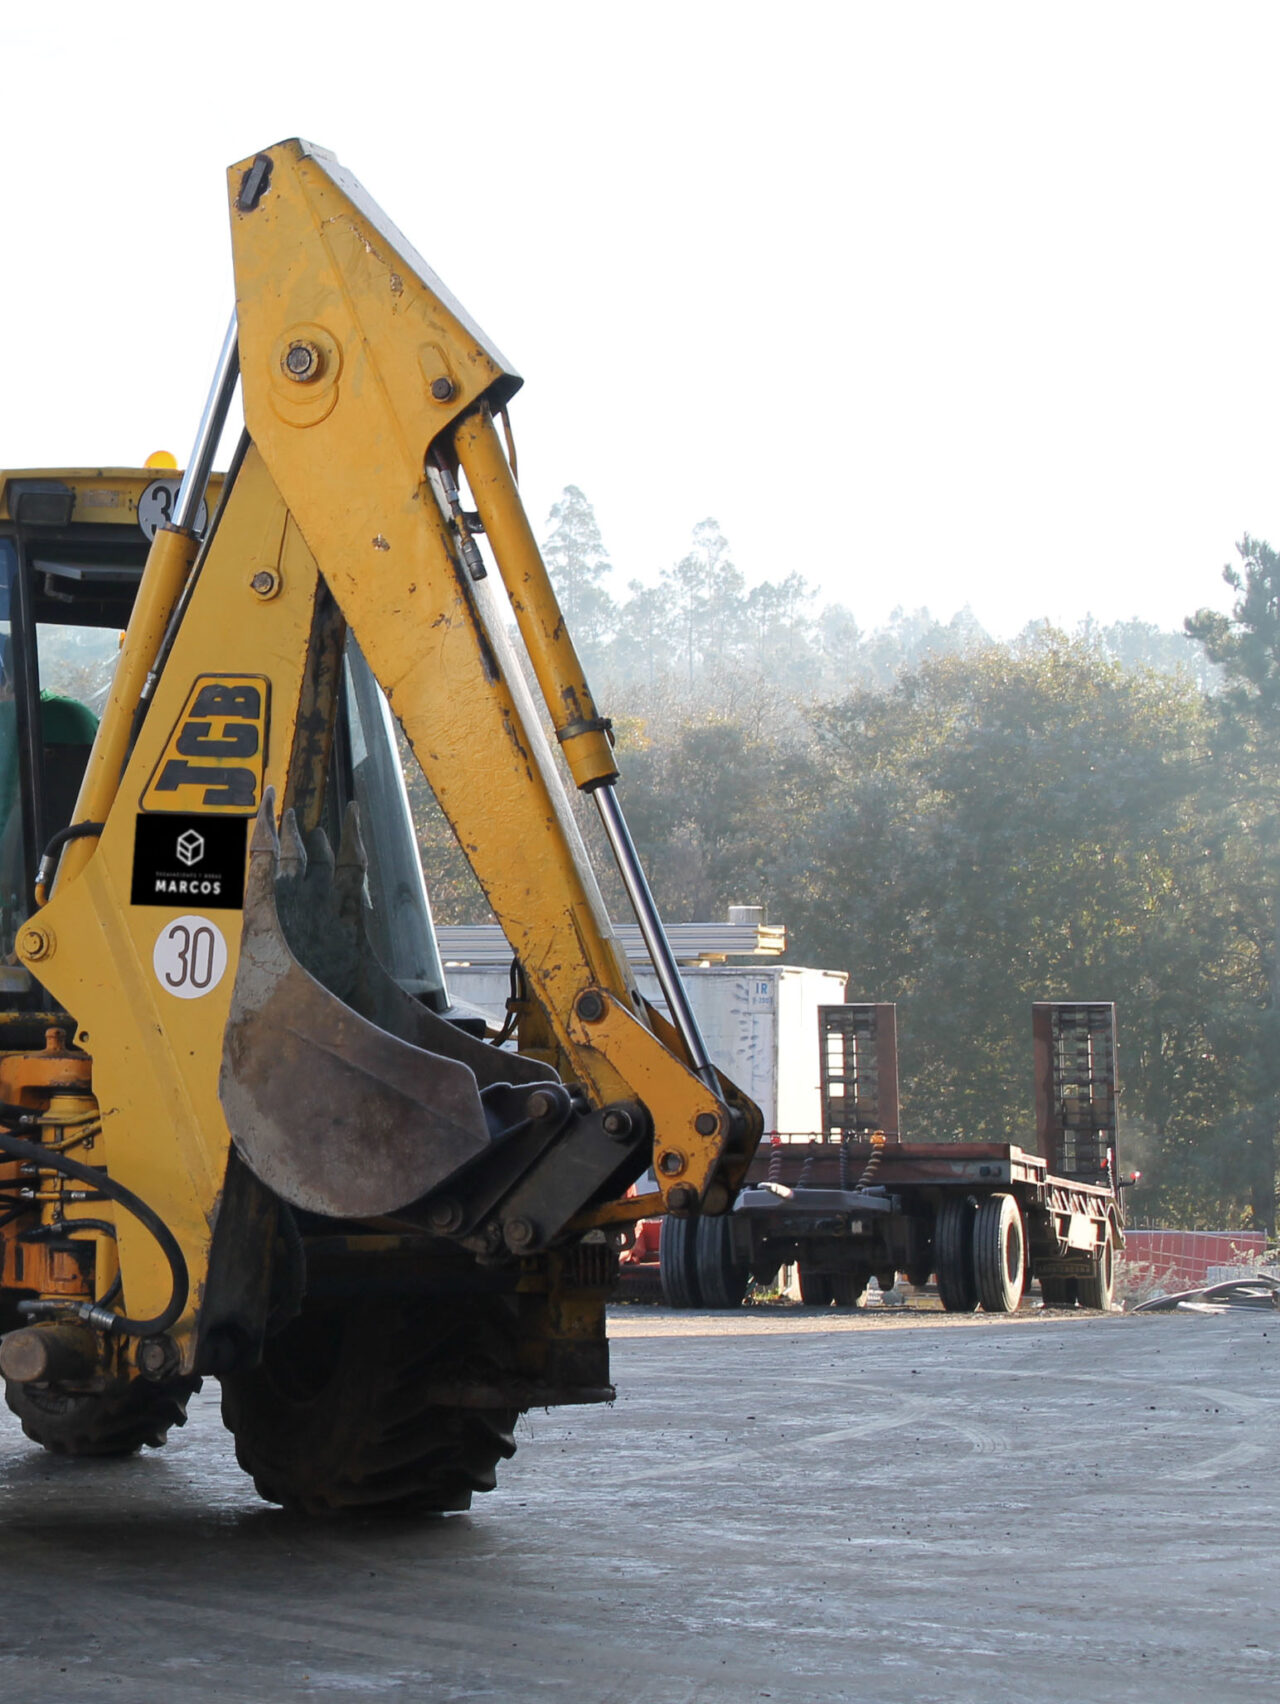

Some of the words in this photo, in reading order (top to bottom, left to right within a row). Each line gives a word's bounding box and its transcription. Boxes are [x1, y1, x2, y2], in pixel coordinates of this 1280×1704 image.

[154, 684, 262, 807] JCB
[155, 880, 221, 895] MARCOS
[165, 925, 215, 989] 30
